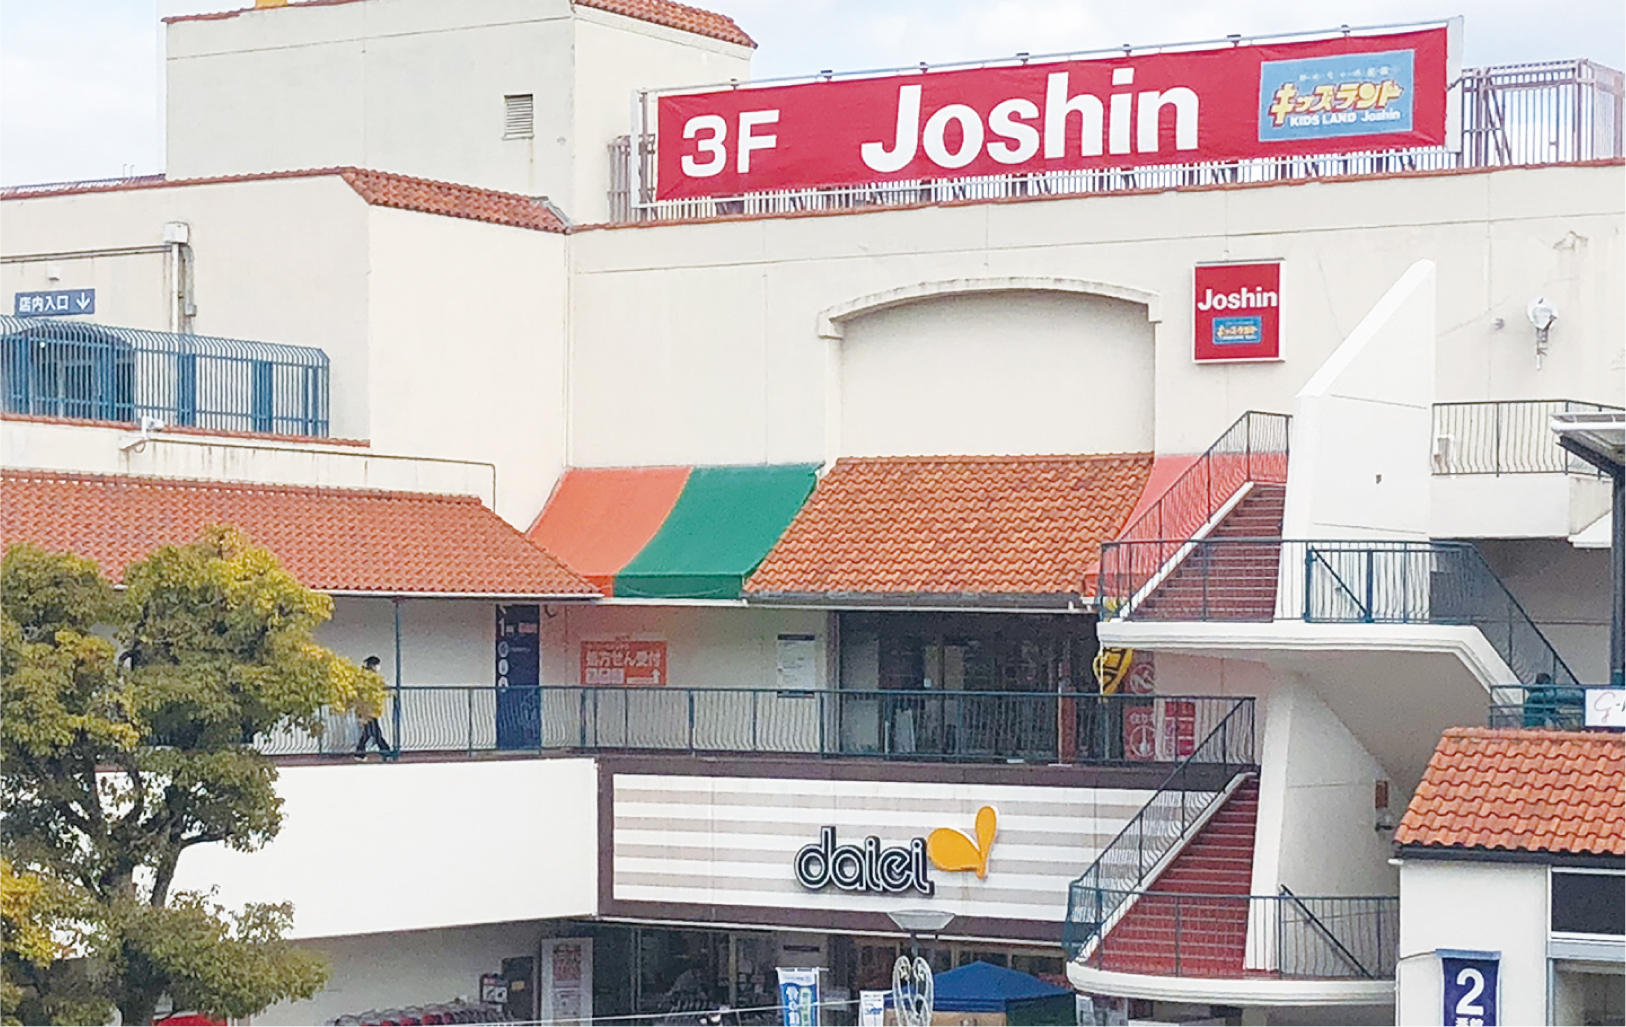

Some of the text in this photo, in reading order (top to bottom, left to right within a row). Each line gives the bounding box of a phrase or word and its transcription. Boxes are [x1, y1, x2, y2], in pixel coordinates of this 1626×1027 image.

[681, 67, 1199, 178] 3F Joshin
[1269, 80, 1403, 127] キッズランド
[1290, 108, 1401, 127] KIDS LAND Joshin
[19, 295, 69, 313] 店内入口
[1197, 286, 1278, 311] Joshin
[794, 825, 935, 896] daiei
[1456, 967, 1485, 1016] 2
